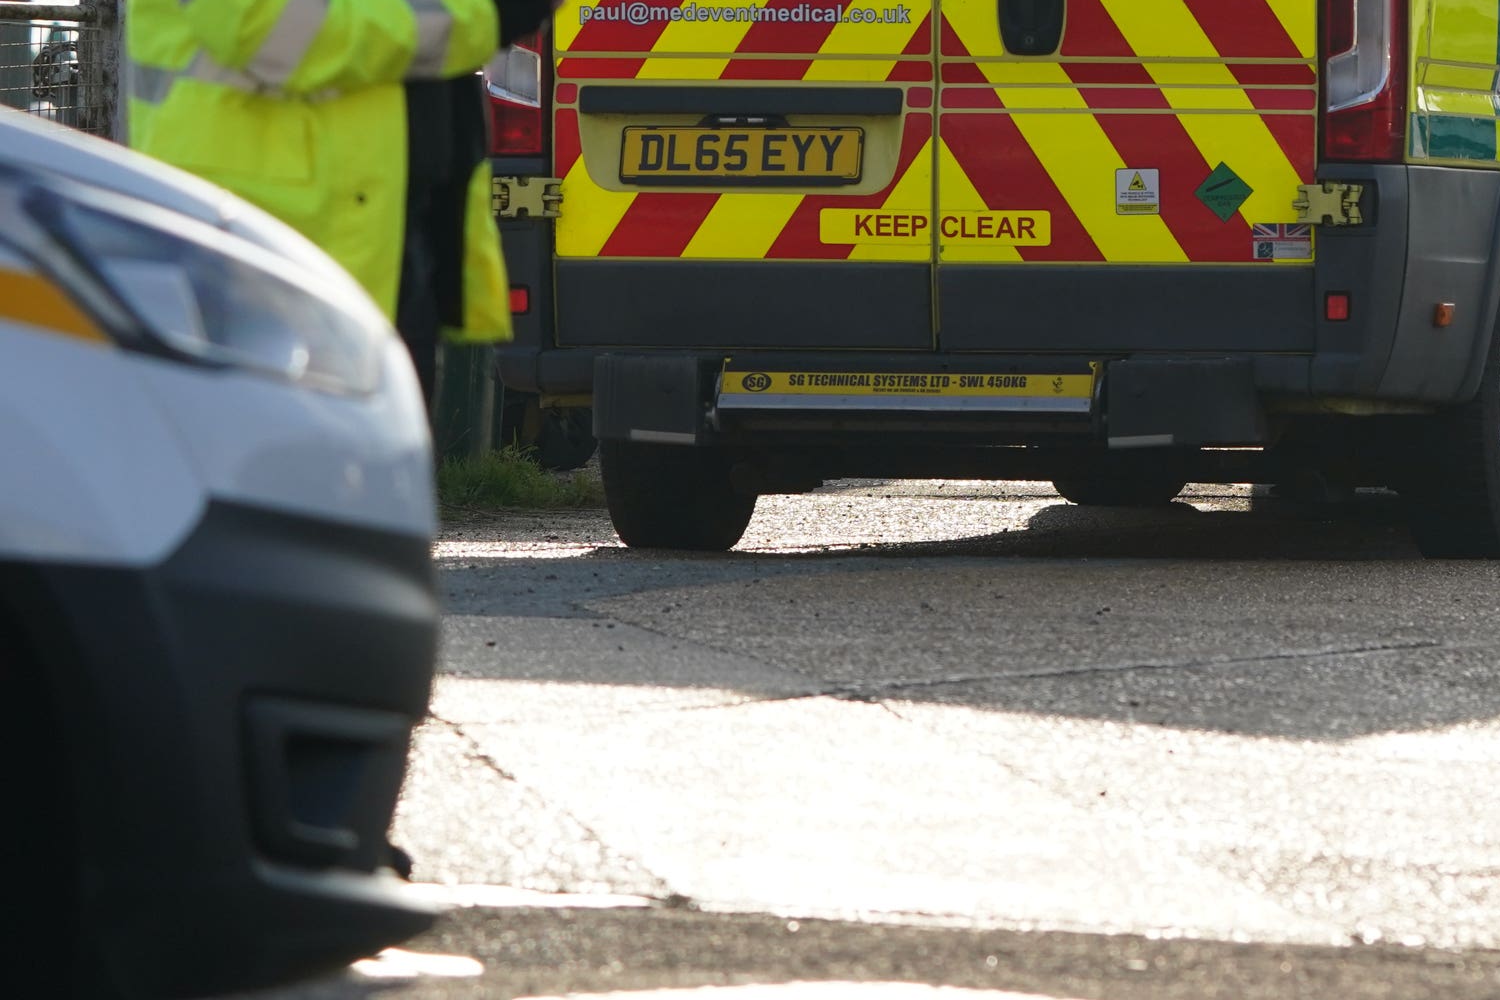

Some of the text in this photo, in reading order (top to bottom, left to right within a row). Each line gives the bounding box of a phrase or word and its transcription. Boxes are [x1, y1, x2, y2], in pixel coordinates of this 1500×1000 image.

[579, 1, 911, 25] paul@medeventmedical.co.uk
[638, 134, 844, 171] DL65 EYY
[855, 214, 1037, 239] KEEP CLEAR
[748, 376, 765, 388] SG
[788, 374, 805, 386] SG
[808, 374, 871, 386] TECHNICAL
[873, 375, 927, 387] SYSTEMS
[930, 375, 950, 388] LTD
[959, 375, 984, 388] SWL
[987, 376, 1027, 388] 450KG
